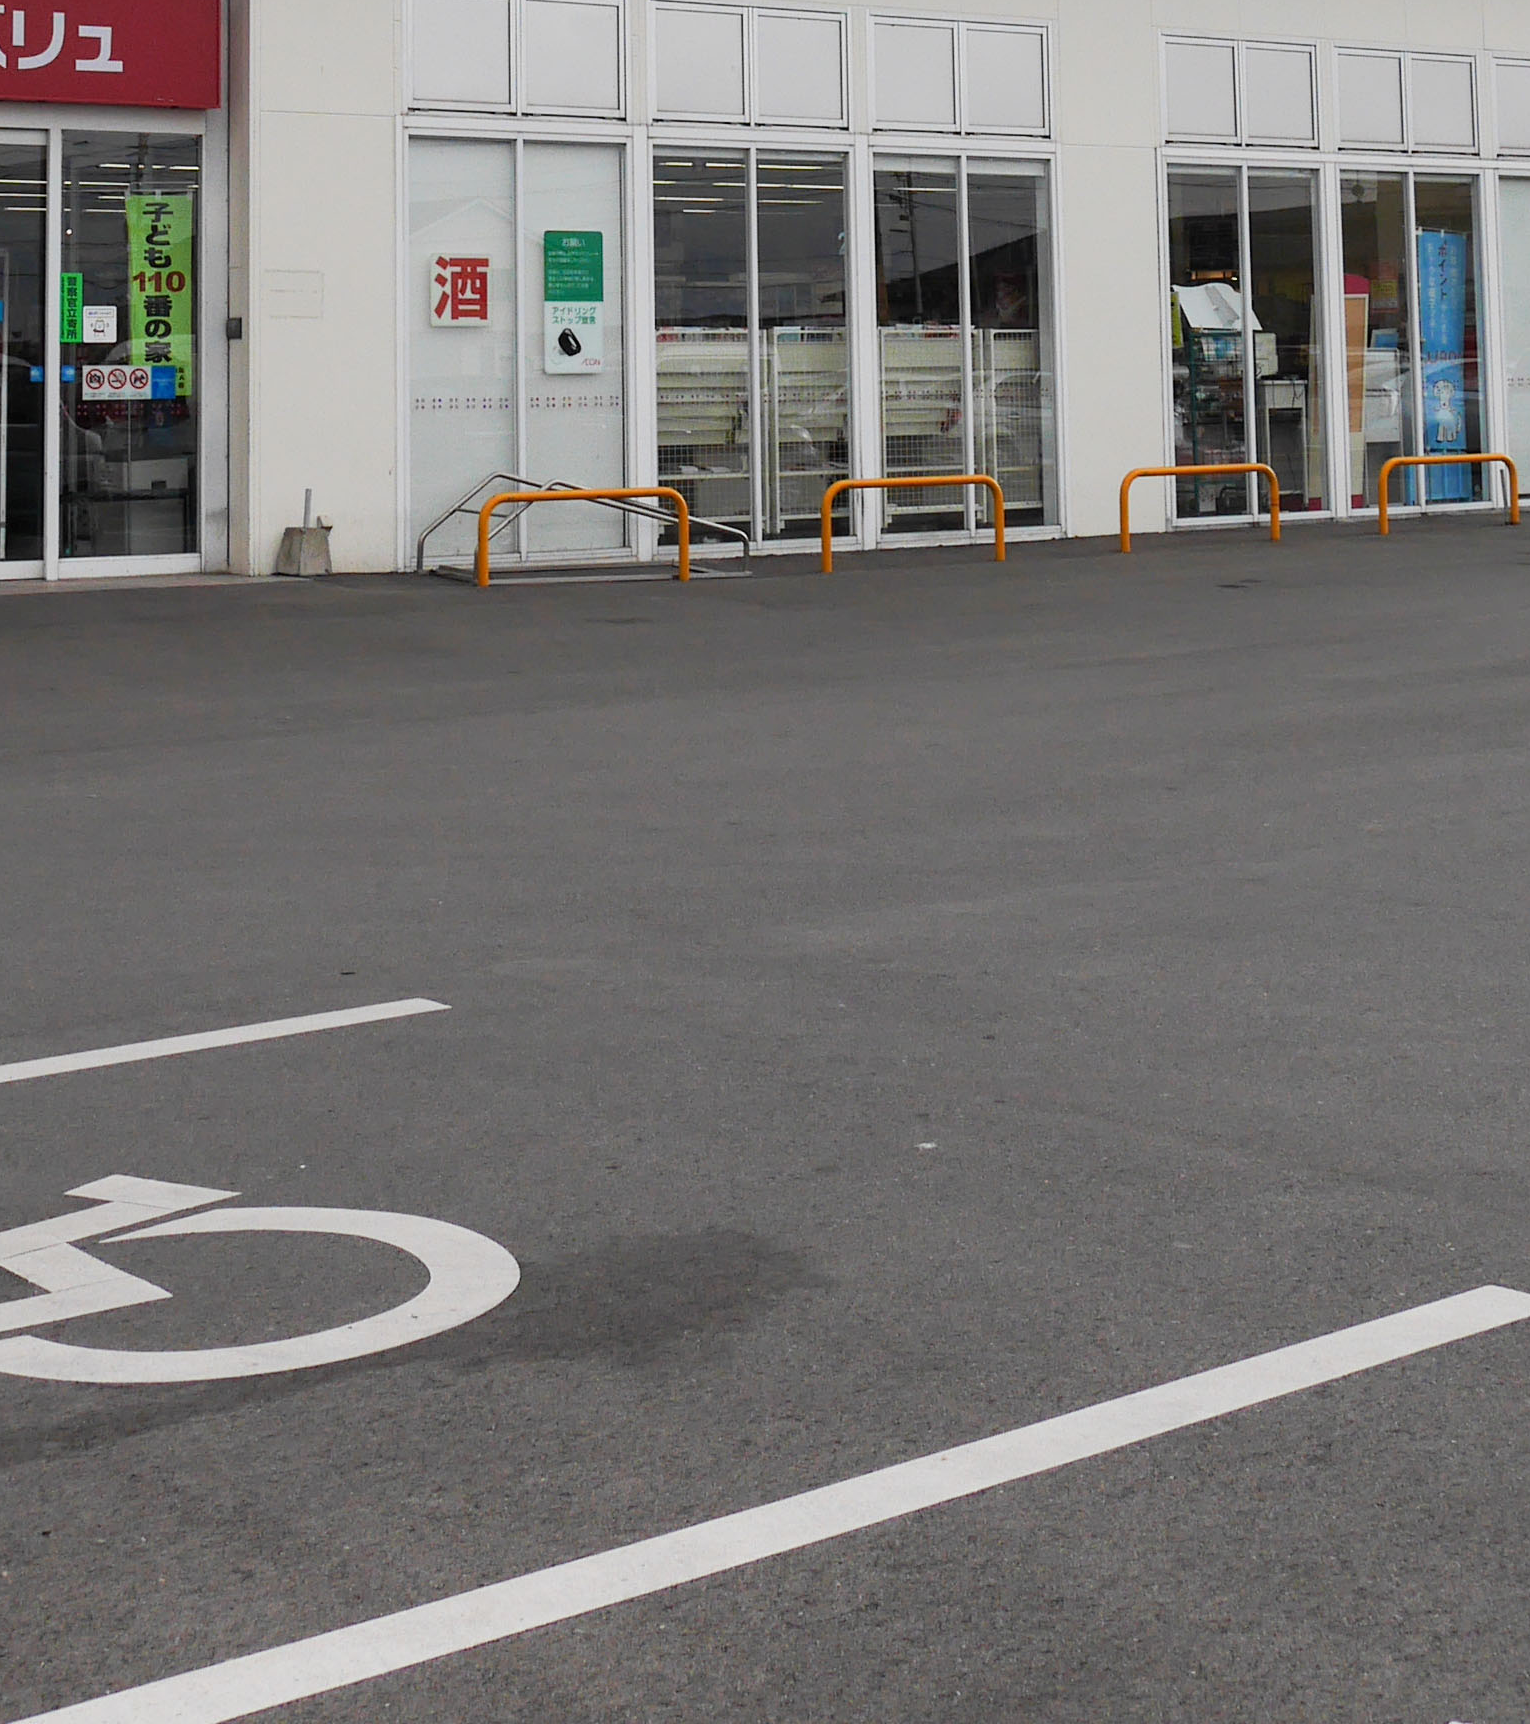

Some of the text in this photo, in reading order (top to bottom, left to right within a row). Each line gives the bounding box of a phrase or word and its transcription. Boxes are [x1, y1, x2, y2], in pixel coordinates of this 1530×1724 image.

[133, 202, 186, 363] 子ども110番の家
[434, 256, 489, 320] 酒
